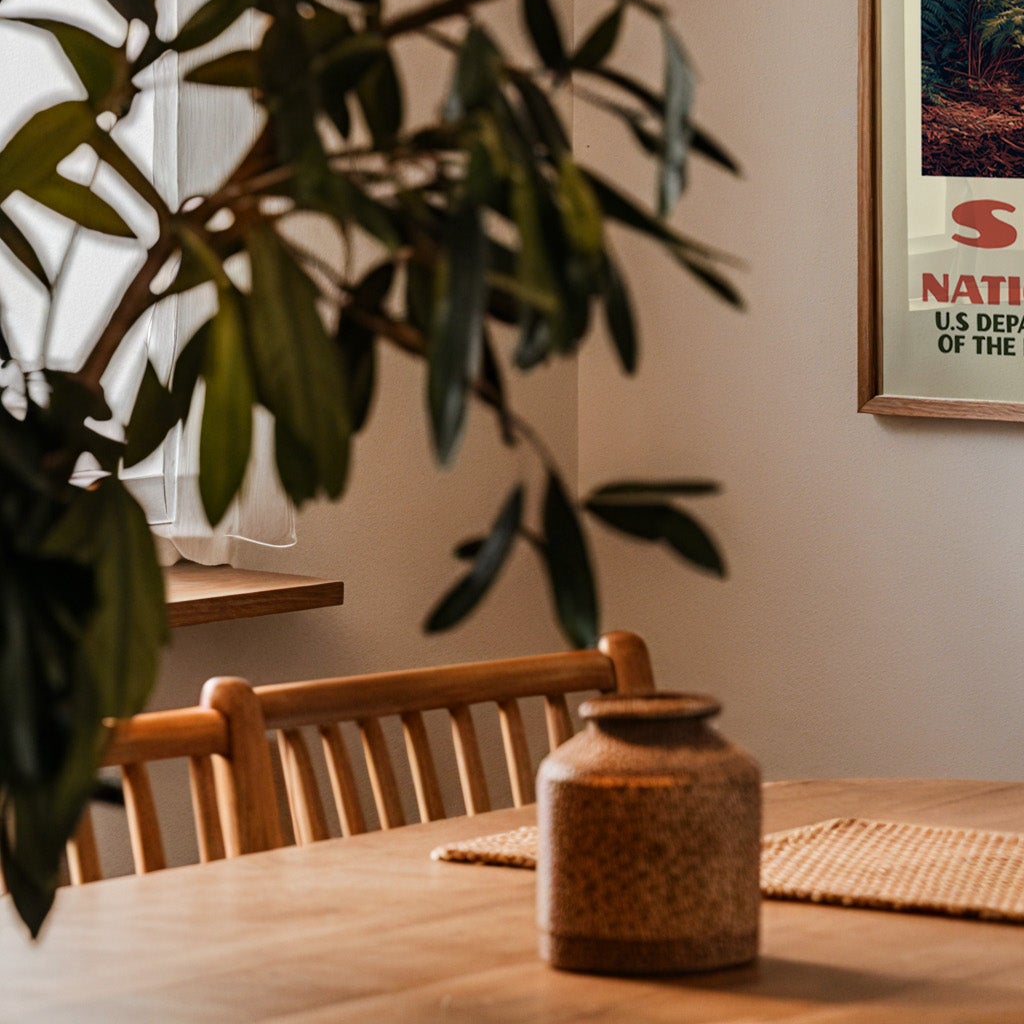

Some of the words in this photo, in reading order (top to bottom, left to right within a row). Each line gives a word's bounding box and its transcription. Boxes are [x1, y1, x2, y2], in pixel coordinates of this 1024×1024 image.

[935, 311, 969, 331] U.S
[938, 334, 965, 354] OF
[972, 336, 1016, 356] THE
